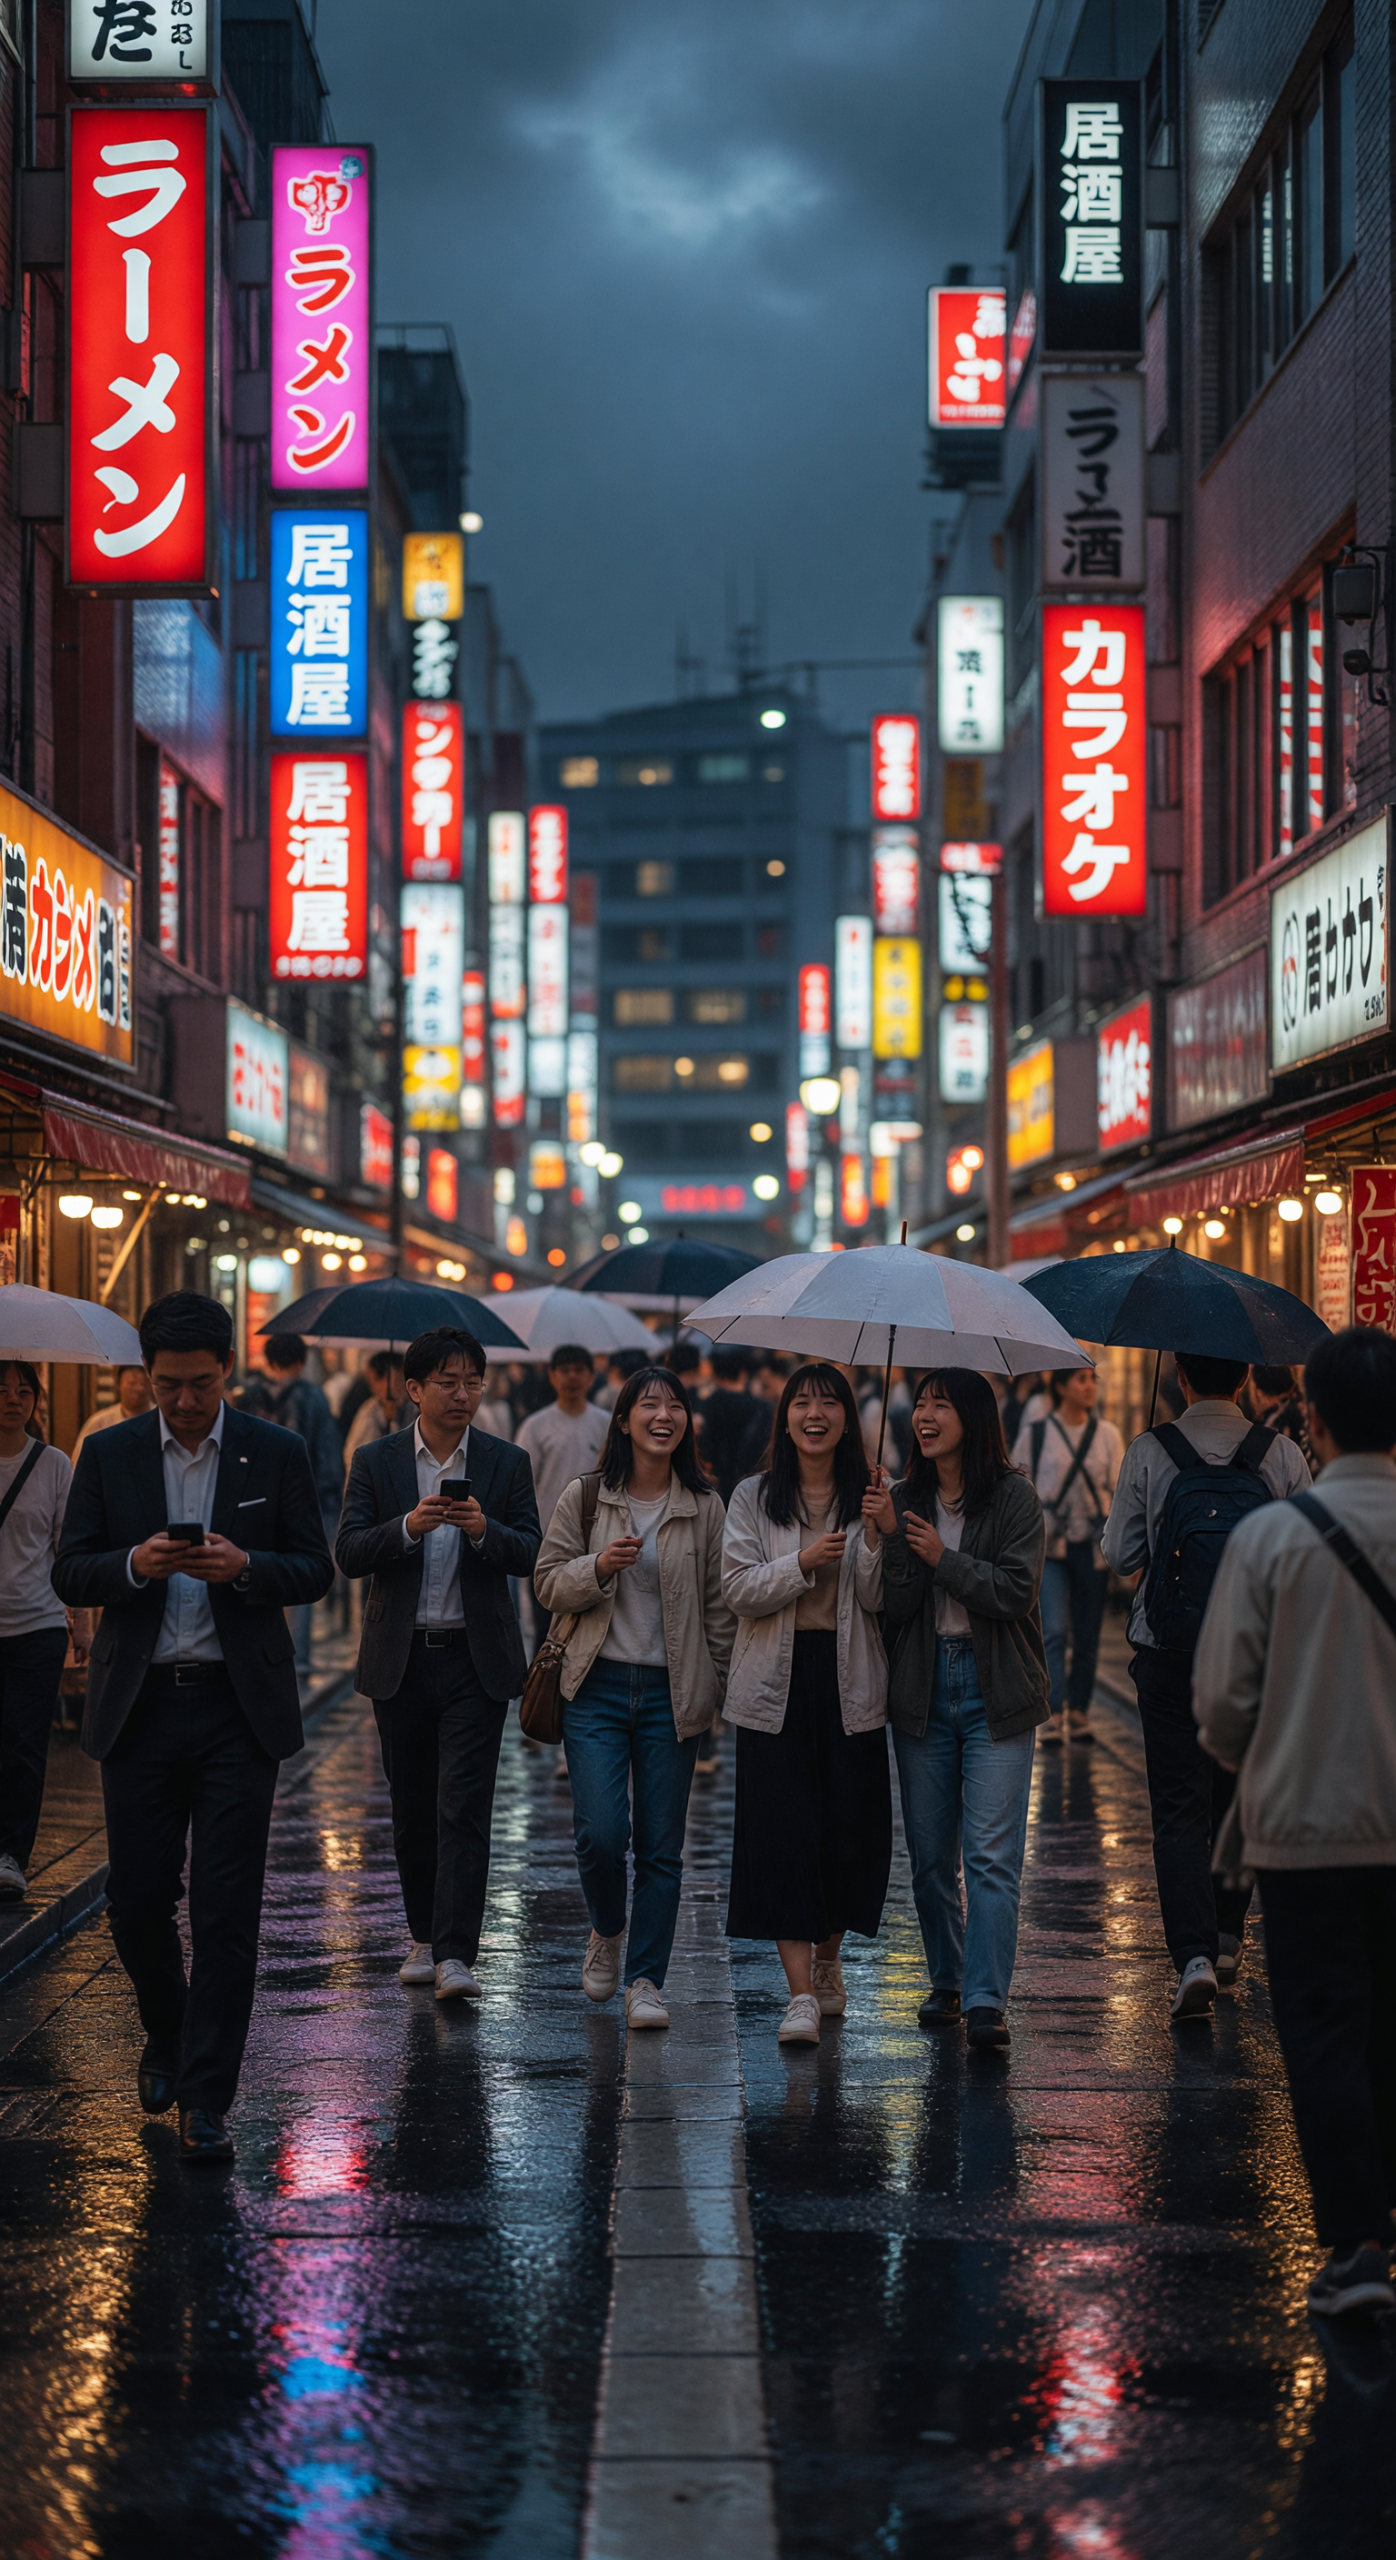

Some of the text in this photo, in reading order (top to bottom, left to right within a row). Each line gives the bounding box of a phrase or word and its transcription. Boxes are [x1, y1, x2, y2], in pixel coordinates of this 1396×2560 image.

[1060, 102, 1124, 284] 居酒屋
[91, 139, 187, 558] ラーメン
[285, 244, 356, 474] ラメン
[285, 524, 354, 726] 居酒屋
[286, 761, 352, 952] 居酒屋
[1060, 619, 1130, 902] カラオケ
